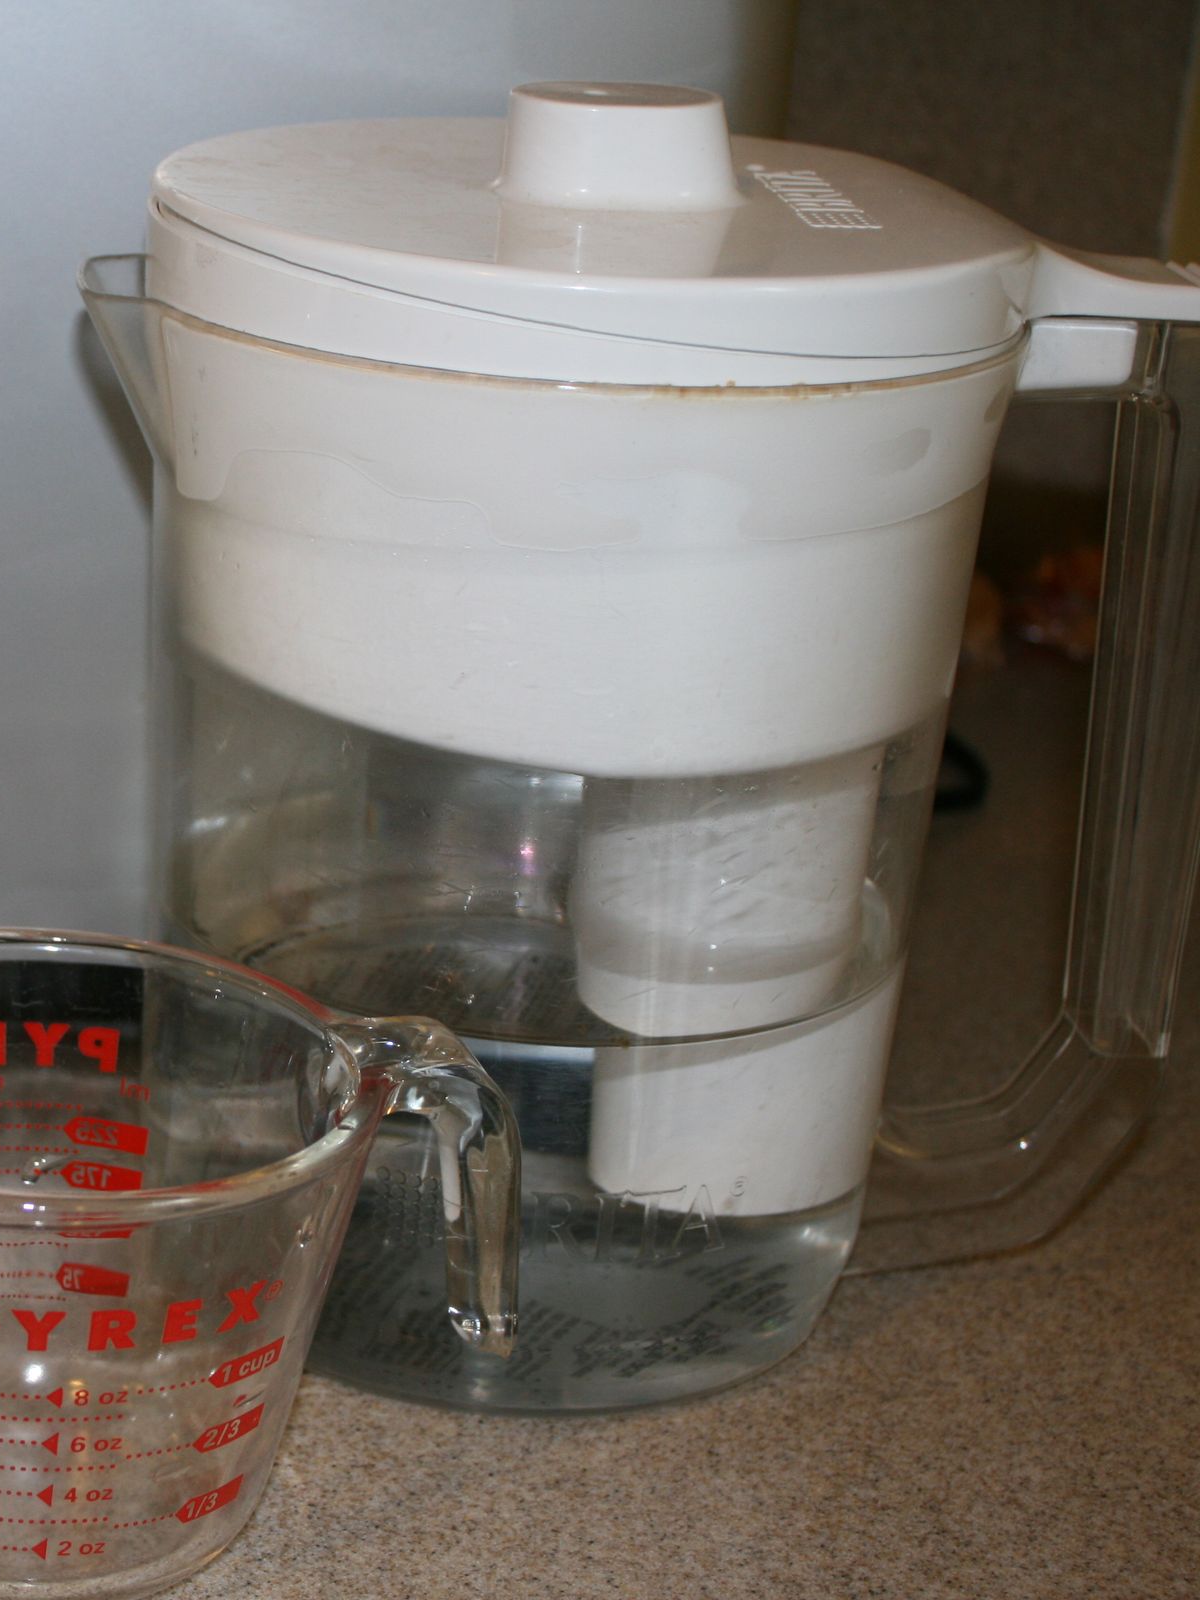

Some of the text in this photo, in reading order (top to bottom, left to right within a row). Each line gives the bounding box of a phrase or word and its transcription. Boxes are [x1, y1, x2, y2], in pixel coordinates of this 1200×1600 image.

[221, 1350, 276, 1382] 1 cup
[74, 1390, 128, 1406] 8 oz
[202, 1419, 241, 1449] 2/3
[70, 1437, 123, 1453] 6 oz
[64, 1487, 114, 1504] 4 oz
[186, 1492, 219, 1519] 1/3
[57, 1542, 106, 1558] 2 oz
